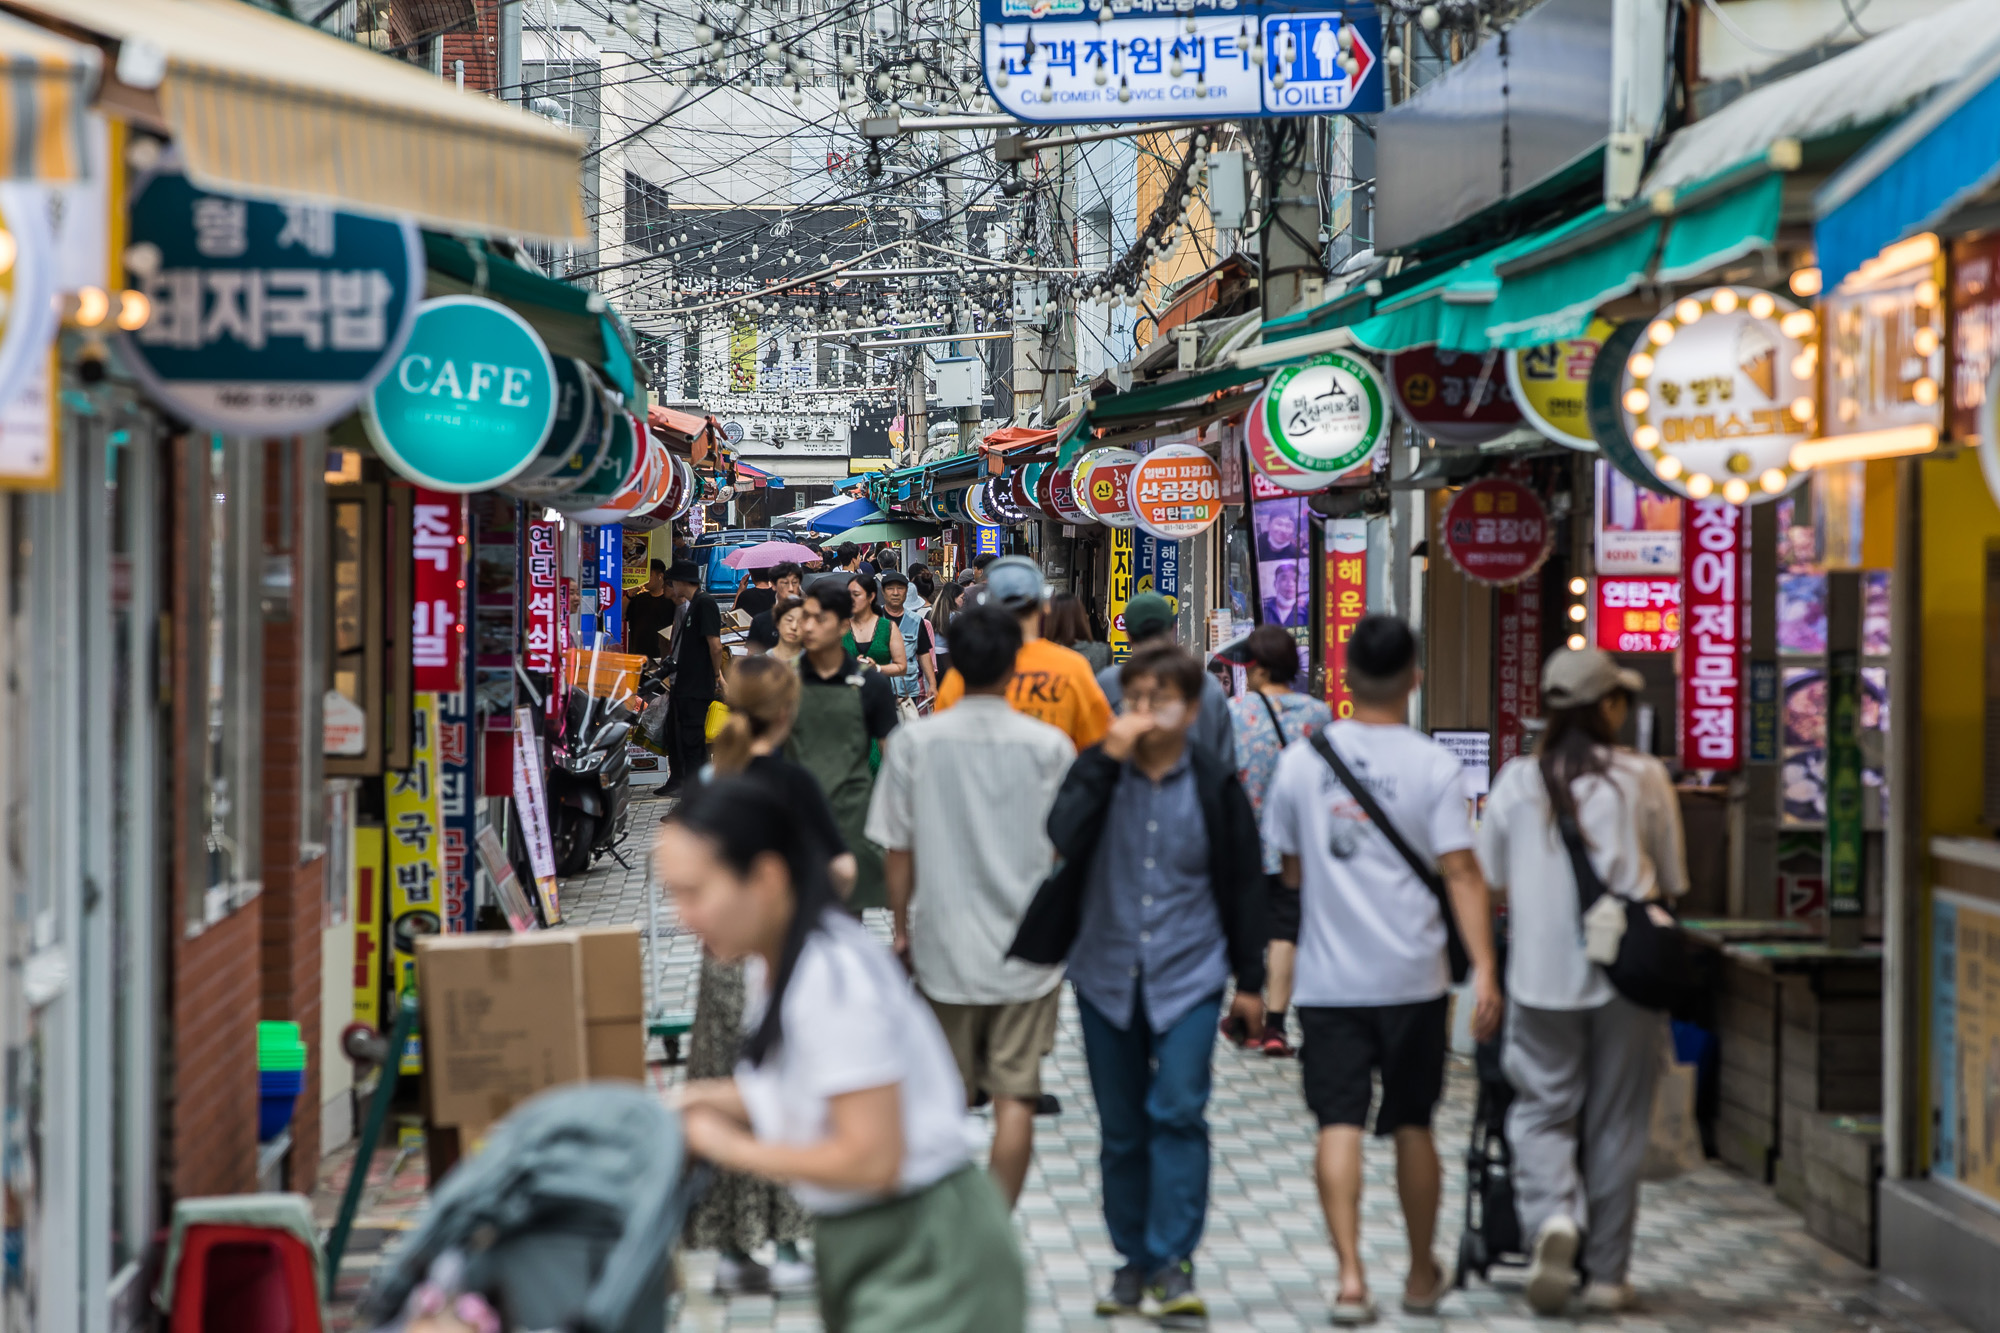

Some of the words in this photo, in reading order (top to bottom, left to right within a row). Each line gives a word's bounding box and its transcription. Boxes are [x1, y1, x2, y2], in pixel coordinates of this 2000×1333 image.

[999, 35, 1249, 77] 고객지원센터
[1021, 89, 1099, 104] CUTOMER
[1273, 85, 1345, 106] TOILET
[399, 354, 532, 407] CAFE
[750, 424, 835, 442] 구포국수
[1180, 465, 1212, 478] 자갈치
[1096, 483, 1110, 497] 산
[1140, 479, 1220, 503] 산곰장어
[1152, 505, 1209, 521] 연탄구이
[1161, 545, 1176, 592] 해운대
[1689, 500, 1740, 760] 장어전문점
